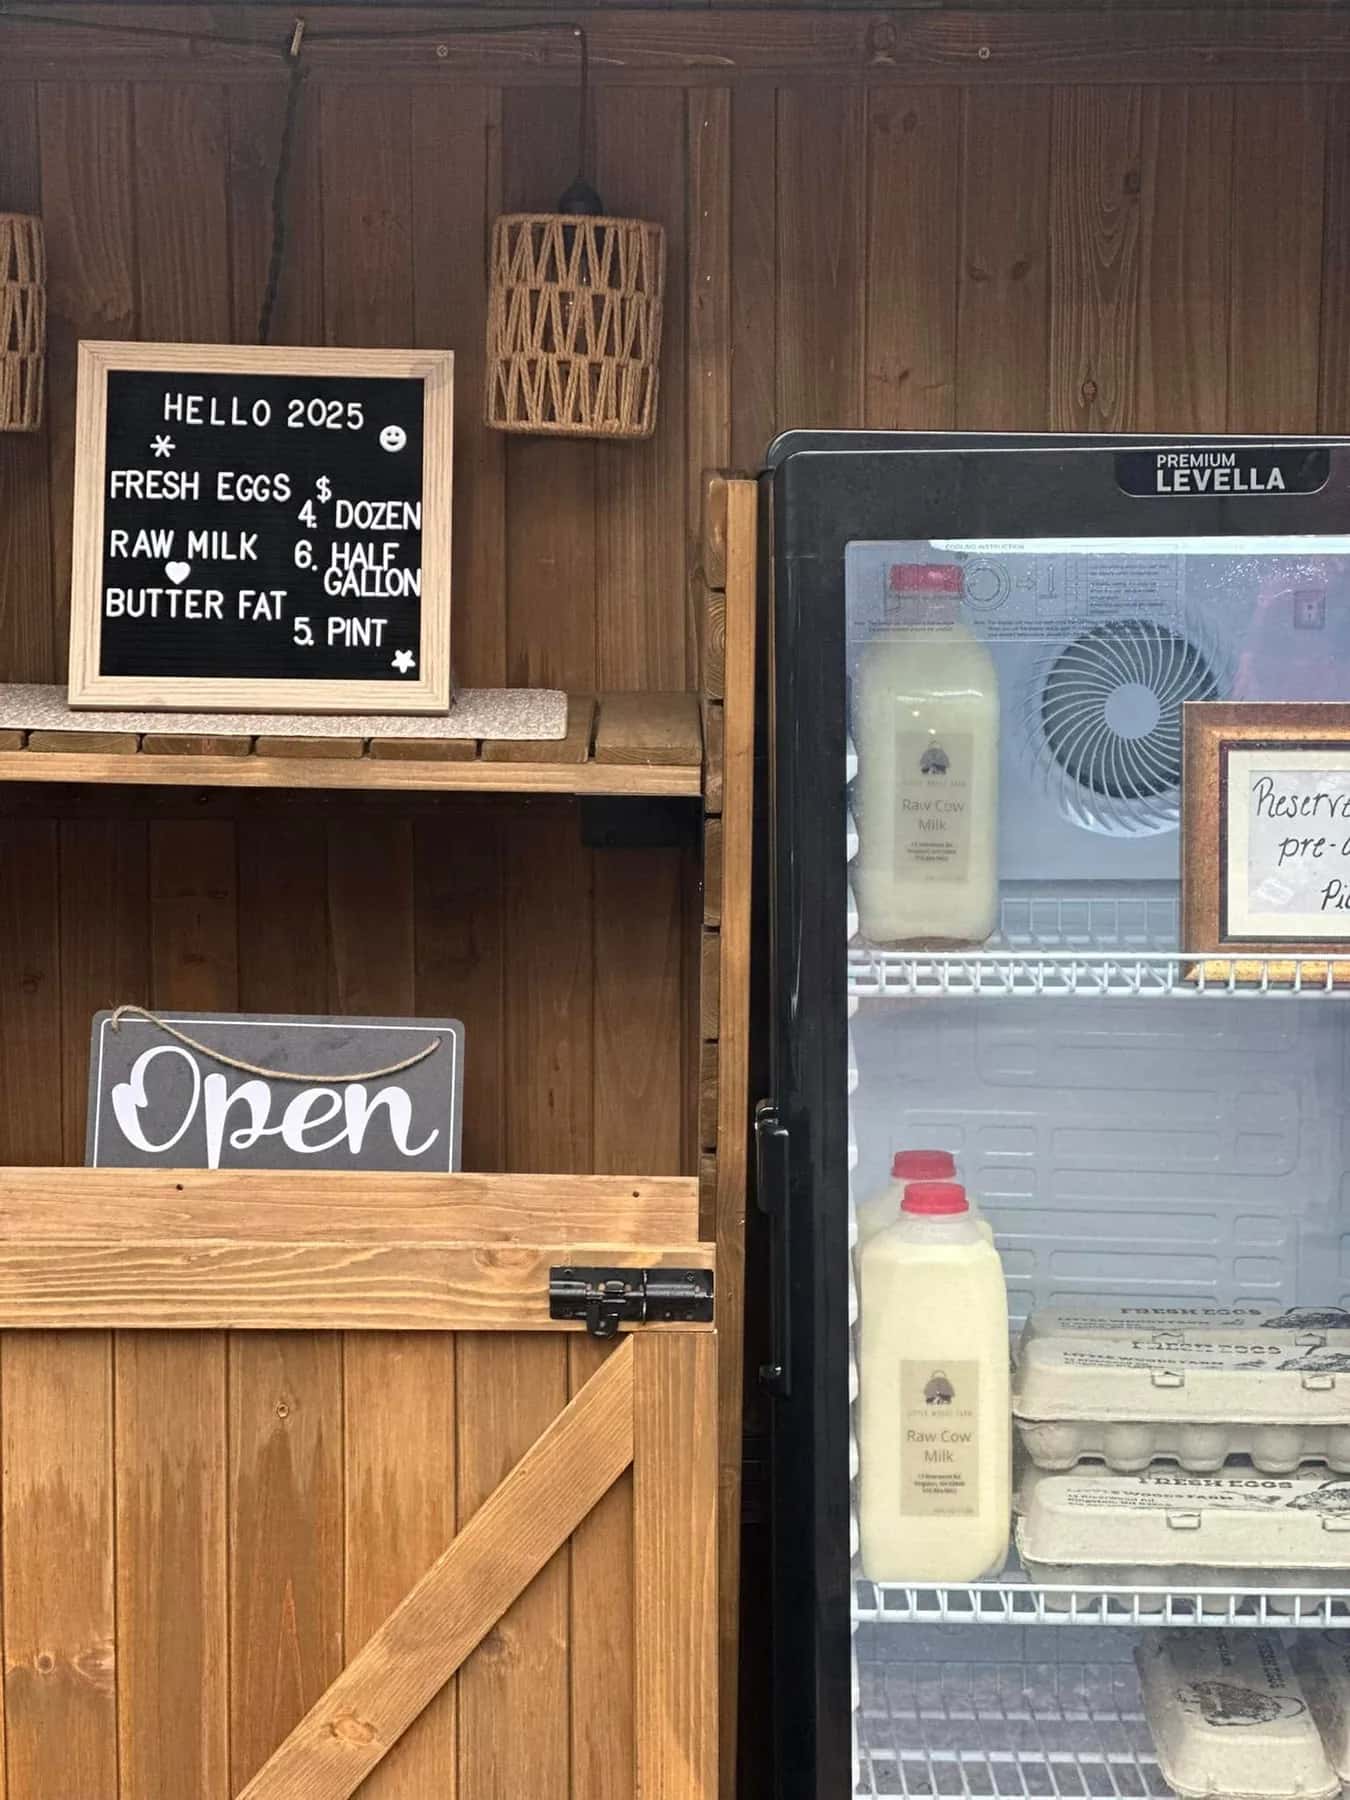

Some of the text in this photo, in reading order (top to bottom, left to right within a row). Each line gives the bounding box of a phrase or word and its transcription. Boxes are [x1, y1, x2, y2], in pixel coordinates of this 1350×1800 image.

[164, 392, 364, 430] HELLO 2025
[1156, 453, 1236, 468] PREMIUM
[110, 469, 333, 504] FRESH EGGS $
[1156, 467, 1286, 492] LEVELLA
[297, 499, 421, 531] 4. DOZEN
[109, 528, 259, 561] RAW MILK
[294, 539, 401, 572] 6. HALF
[323, 566, 421, 598] GALLON
[105, 587, 288, 621] BUTTER FAT
[293, 616, 388, 648] 5. PINT
[902, 798, 965, 812] Raw Cow
[918, 819, 947, 832] Milk
[111, 1045, 440, 1169] Open
[906, 1429, 972, 1443] Raw Cow
[924, 1450, 954, 1463] Milk
